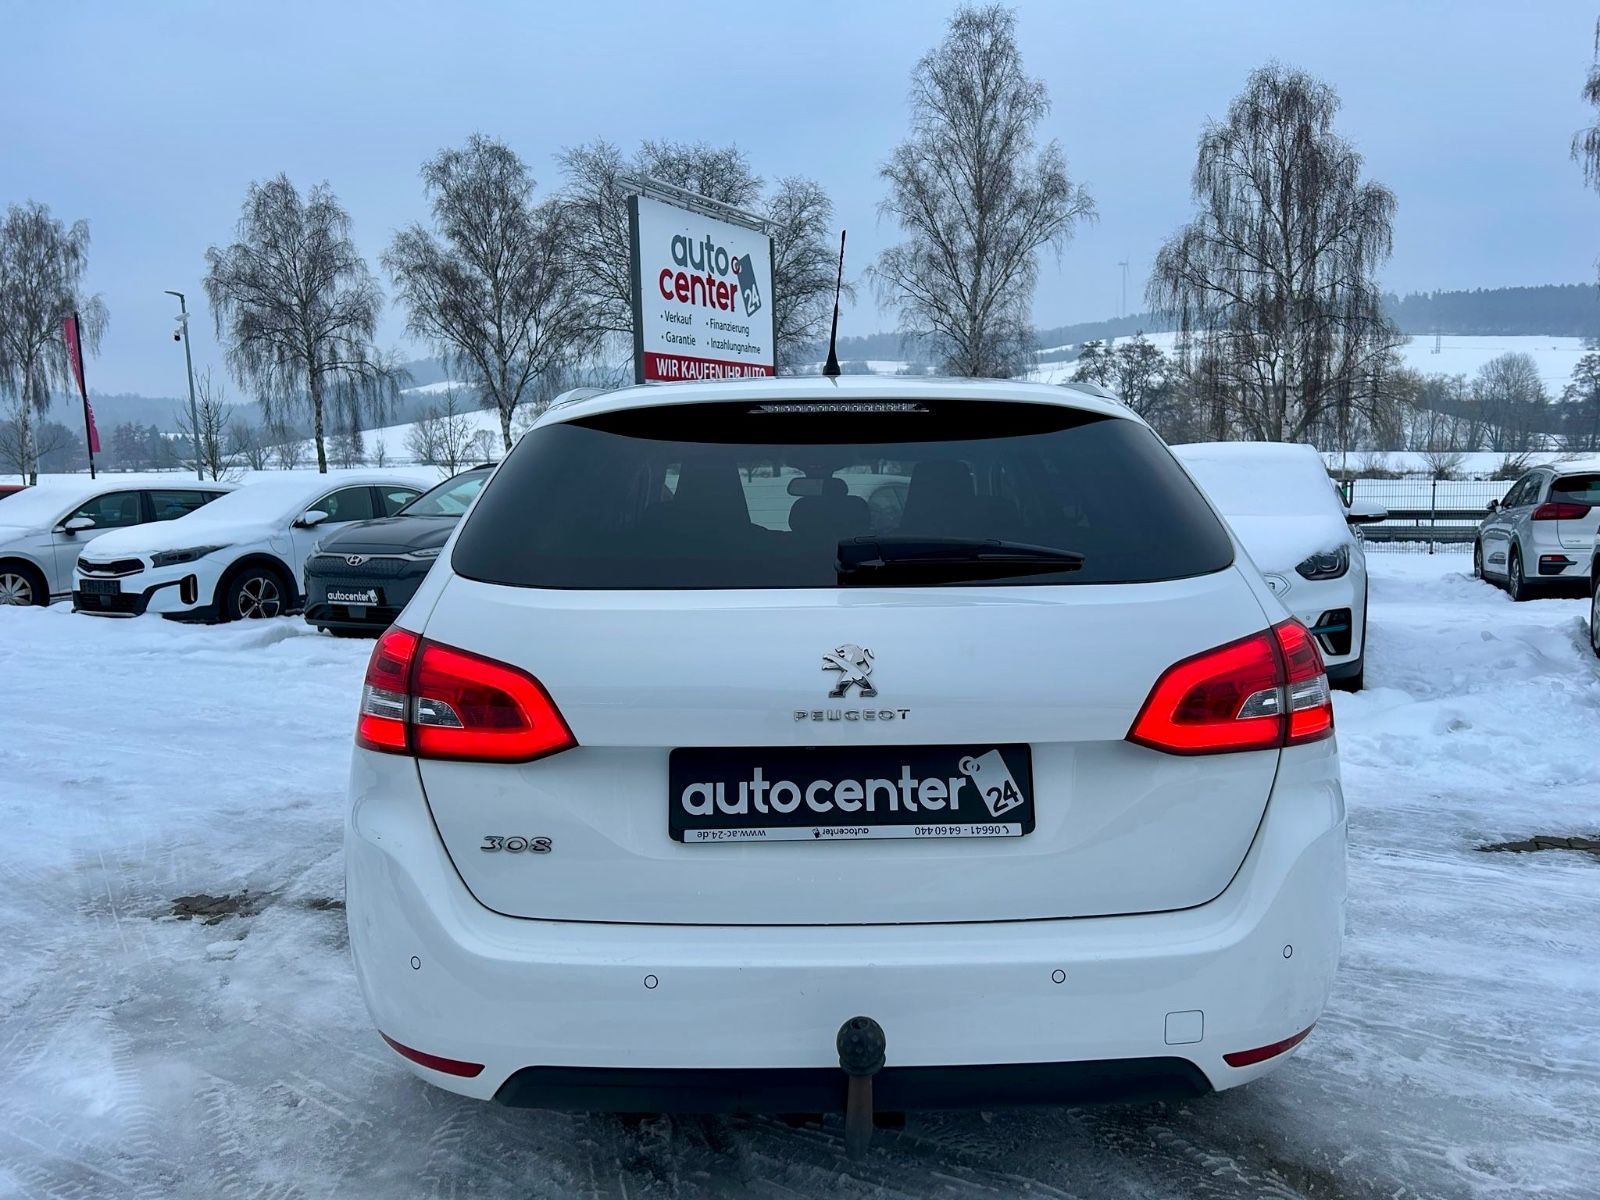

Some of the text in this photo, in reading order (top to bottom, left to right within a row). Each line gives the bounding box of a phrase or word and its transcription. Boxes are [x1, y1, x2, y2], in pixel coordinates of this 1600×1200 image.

[671, 234, 729, 277] auto
[659, 268, 738, 312] center
[744, 283, 761, 311] 24
[664, 310, 692, 326] Verkauf
[709, 318, 750, 337] Finanzierung
[665, 331, 697, 346] Garantie
[710, 338, 761, 355] Inzahlungnahme
[656, 357, 679, 378] WIR
[681, 360, 723, 380] KAUFEN
[725, 365, 741, 379] IHR
[327, 591, 369, 602] autocenter
[794, 709, 911, 722] PEUGEOT
[682, 765, 967, 816] autocenter
[985, 779, 1019, 814] 24
[696, 830, 767, 841] www.ac-24.de
[822, 828, 869, 837] autocenter
[970, 825, 1001, 835] 06641
[480, 835, 553, 855] 308
